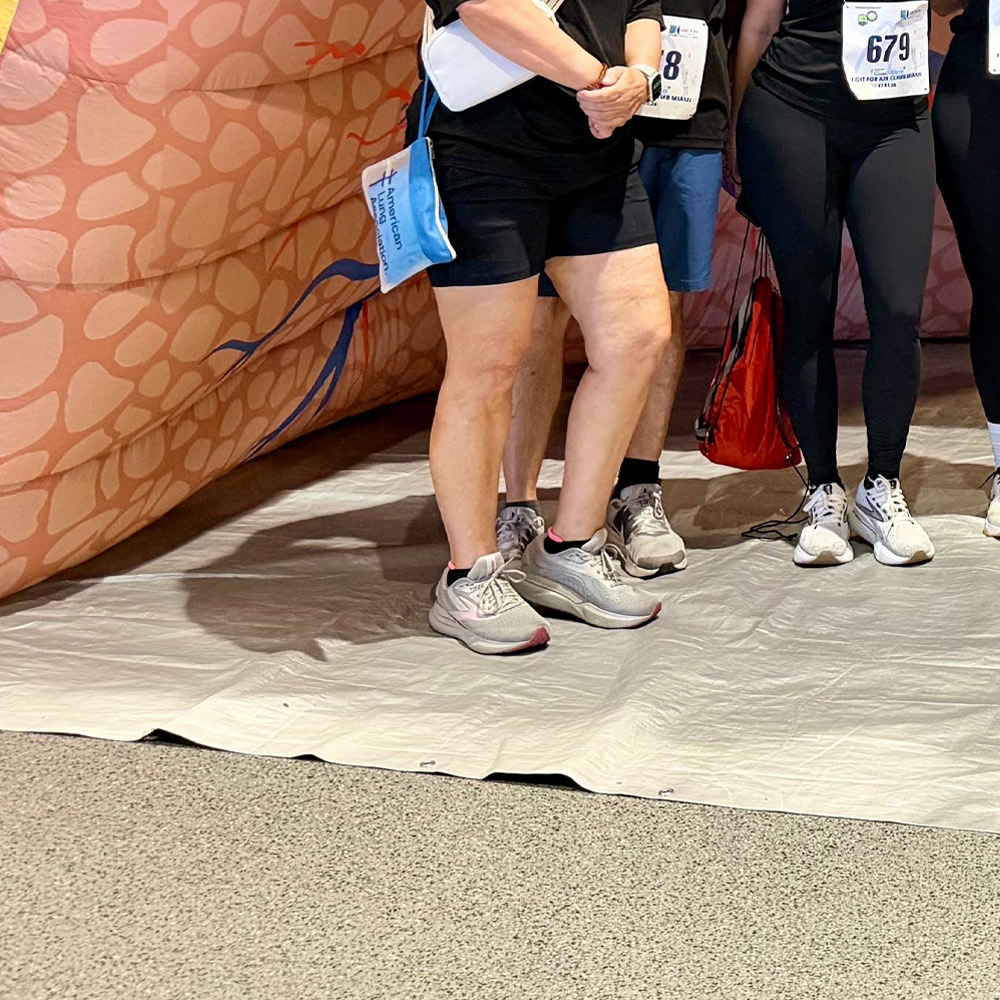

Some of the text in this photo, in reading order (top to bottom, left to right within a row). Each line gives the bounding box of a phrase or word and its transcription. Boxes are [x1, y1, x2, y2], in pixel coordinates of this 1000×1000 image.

[866, 32, 910, 63] 679
[661, 50, 682, 80] 8
[378, 191, 388, 225] Lung
[387, 187, 403, 250] American
